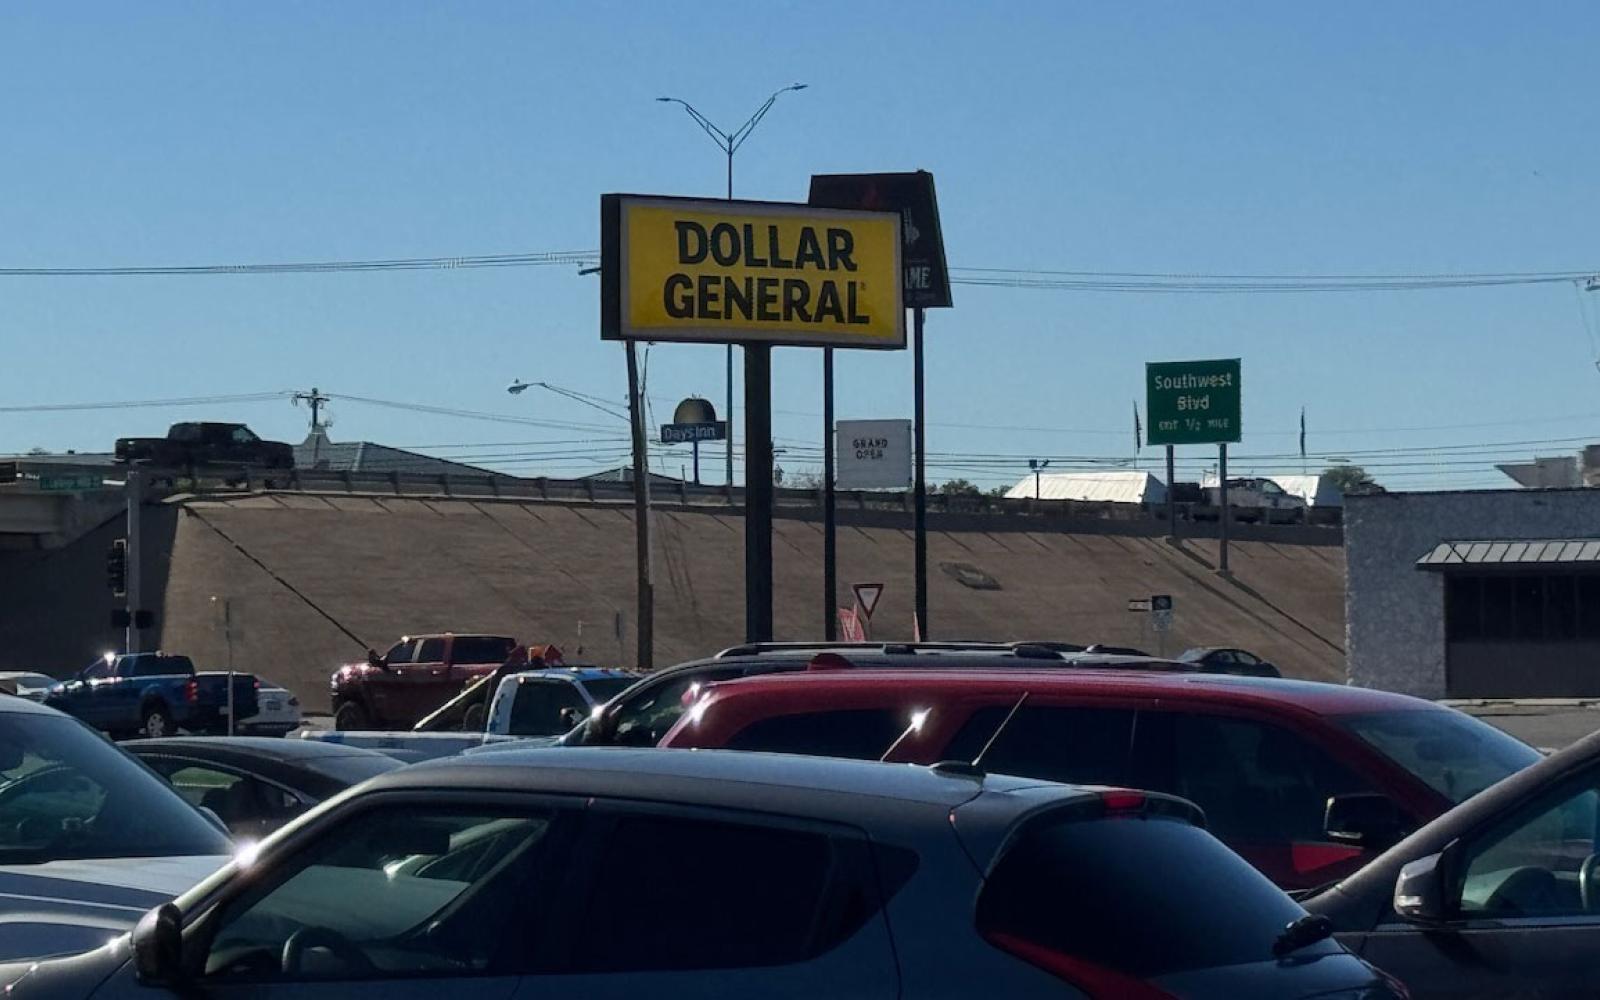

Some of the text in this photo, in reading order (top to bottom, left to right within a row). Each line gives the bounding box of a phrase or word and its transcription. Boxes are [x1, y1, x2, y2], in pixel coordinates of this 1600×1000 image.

[674, 221, 857, 271] DOLLAR
[663, 273, 870, 324] GENERAL
[1154, 373, 1232, 390] Southwest
[1177, 395, 1210, 411] Blvd
[1158, 420, 1178, 431] EXIT
[1207, 418, 1230, 429] MILE
[665, 425, 715, 441] Days Inn
[852, 439, 888, 449] GRAND
